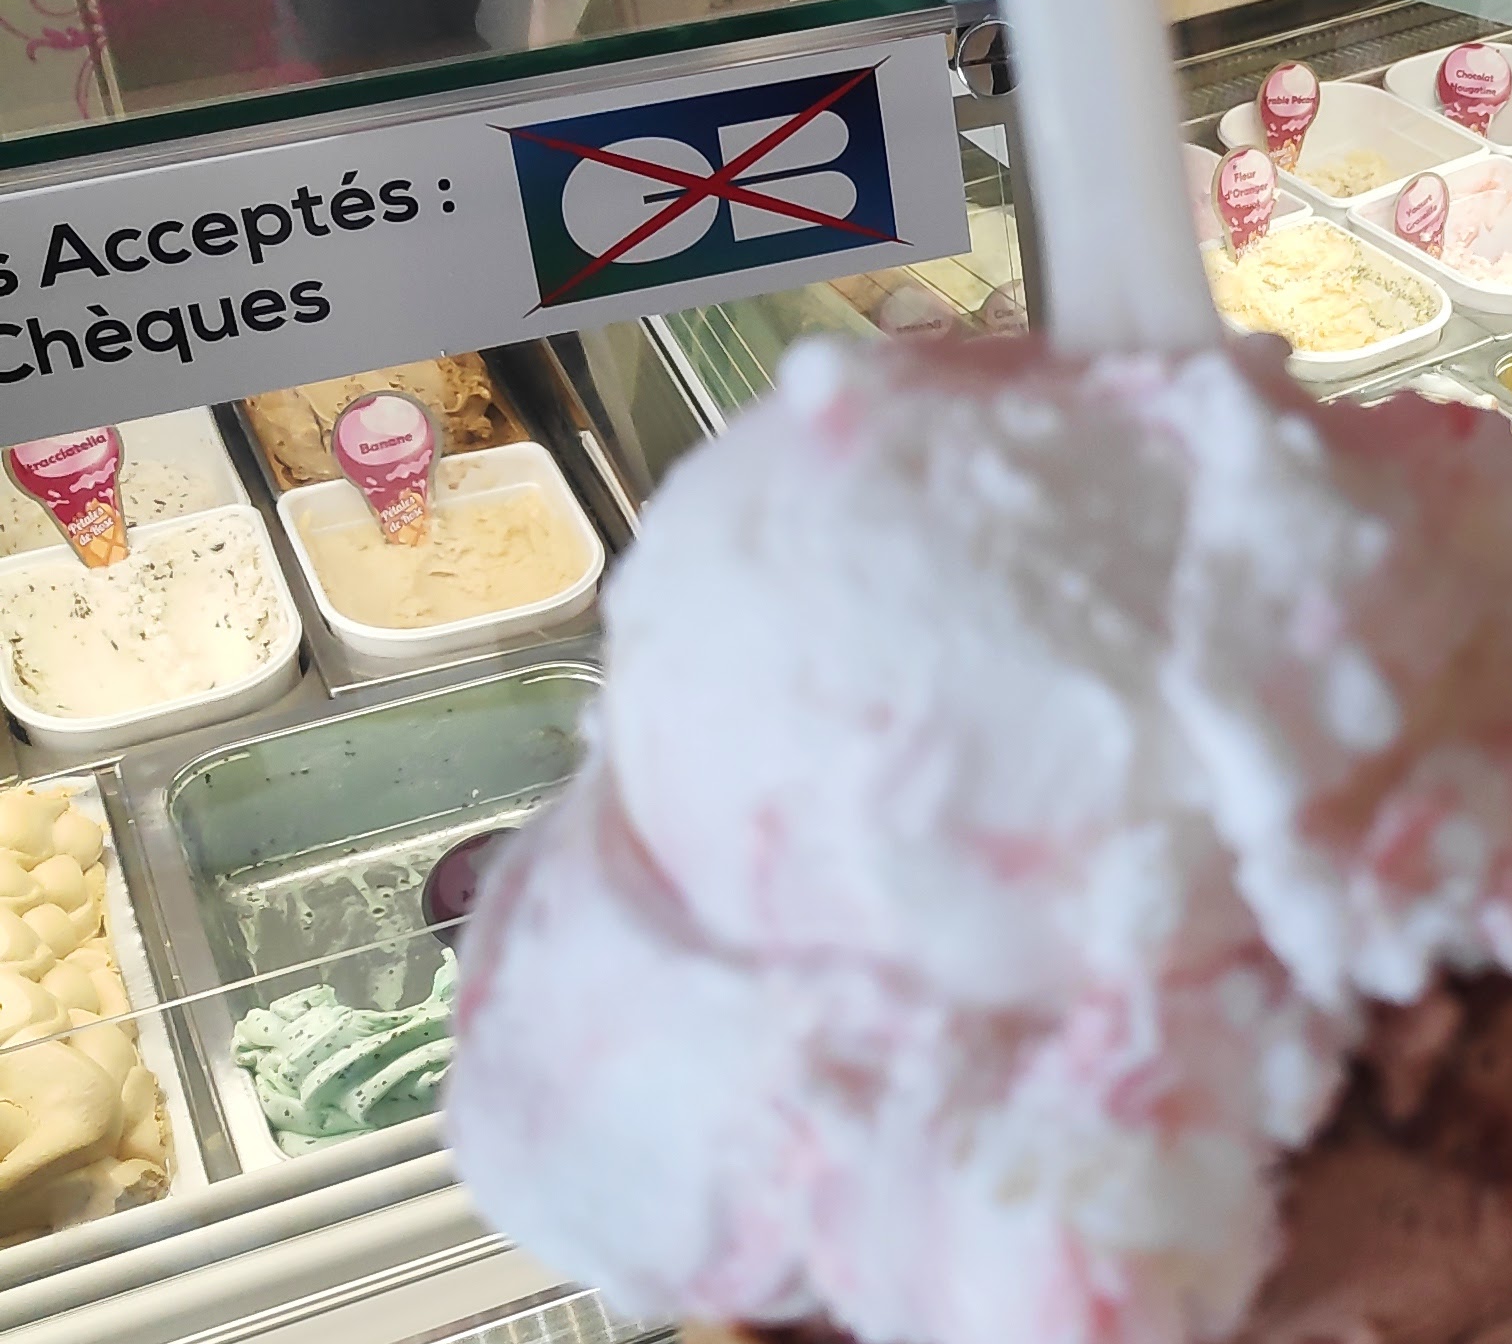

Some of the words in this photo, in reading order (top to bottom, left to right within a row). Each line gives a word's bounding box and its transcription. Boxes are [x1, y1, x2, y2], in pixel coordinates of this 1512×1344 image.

[1456, 69, 1494, 83] Chocolat
[0, 279, 331, 384] Chèques
[24, 433, 107, 472] tracciatella
[359, 433, 413, 455] Banane
[68, 507, 105, 536] Pétales
[381, 496, 416, 523] Pétales
[79, 531, 94, 546] de
[90, 517, 114, 536] Rose
